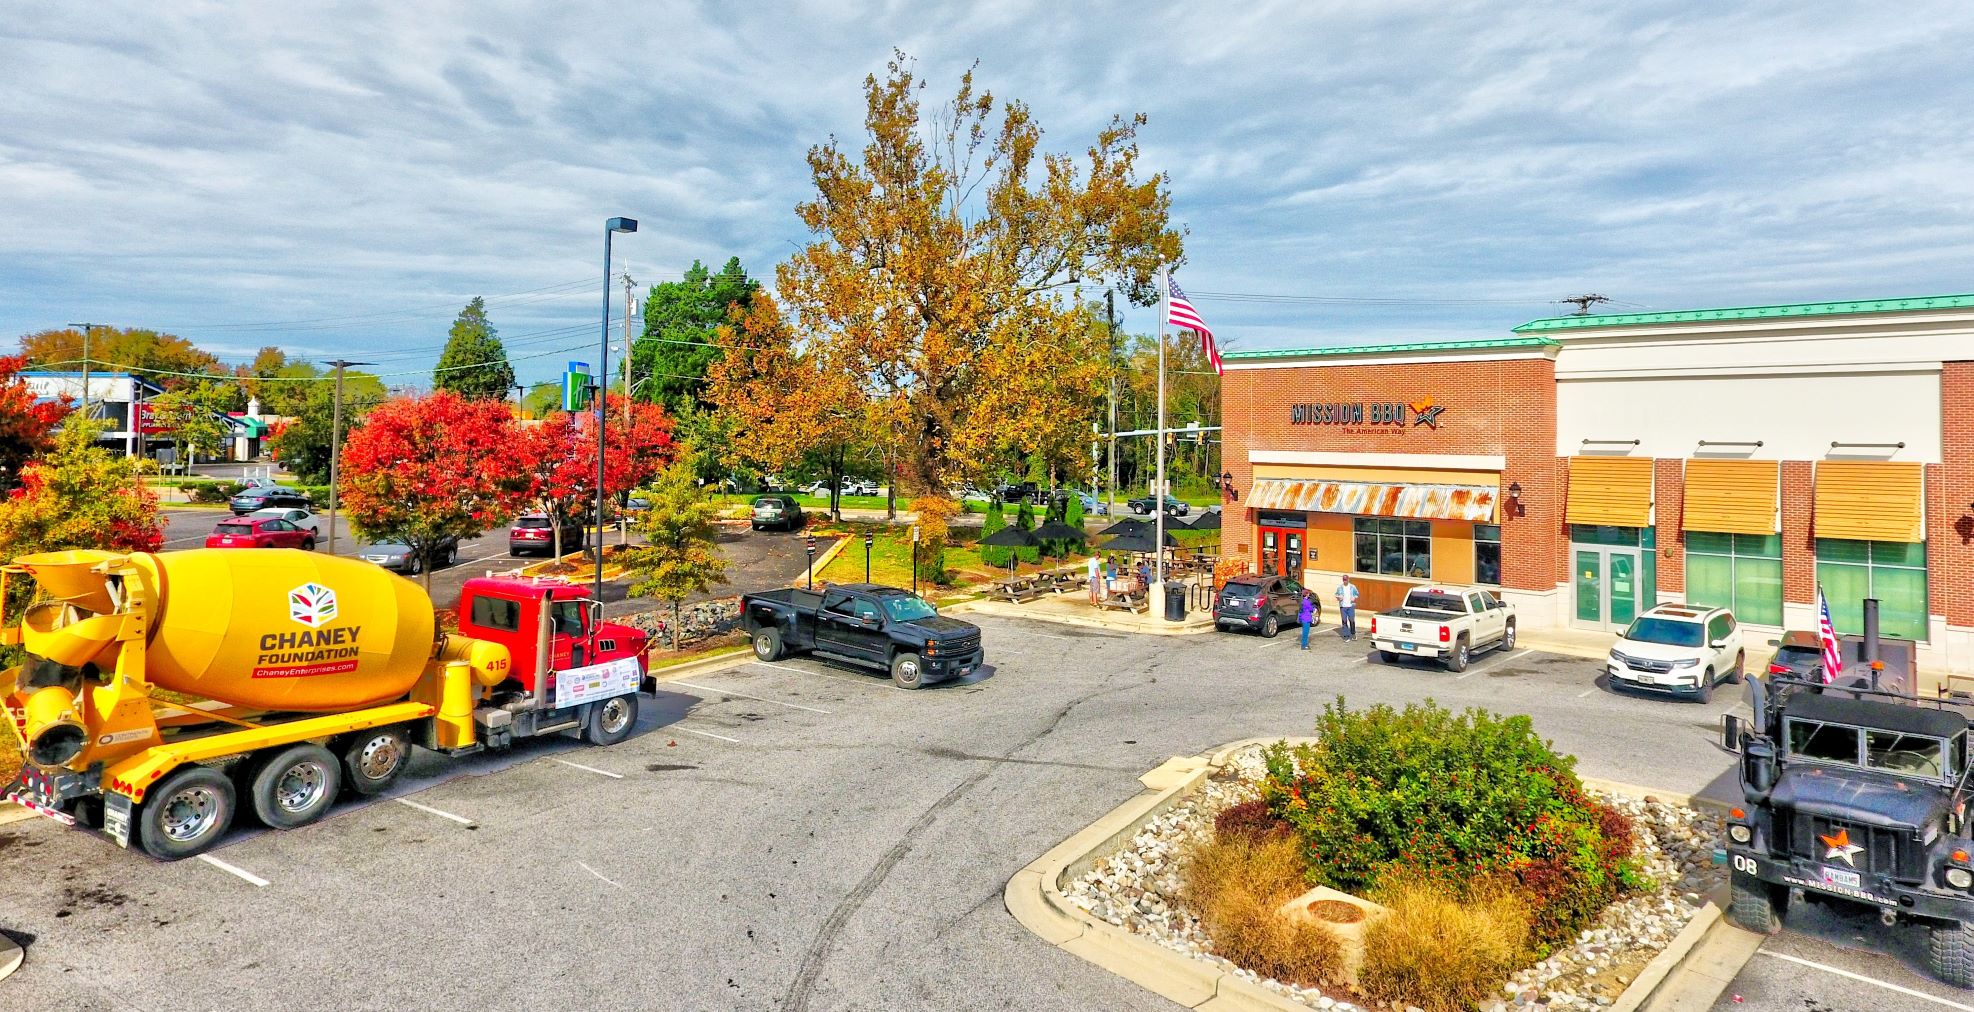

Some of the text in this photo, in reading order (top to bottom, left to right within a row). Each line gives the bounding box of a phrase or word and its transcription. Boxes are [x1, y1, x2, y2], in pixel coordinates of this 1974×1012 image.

[1291, 403, 1405, 426] MISSION BBQ
[1391, 428, 1405, 436] Way
[260, 626, 361, 651] CHANEY
[257, 646, 359, 665] FOUNDATION
[256, 663, 354, 677] ChaneyEnterprises.com
[486, 659, 507, 672] 415
[1734, 854, 1758, 876] 08
